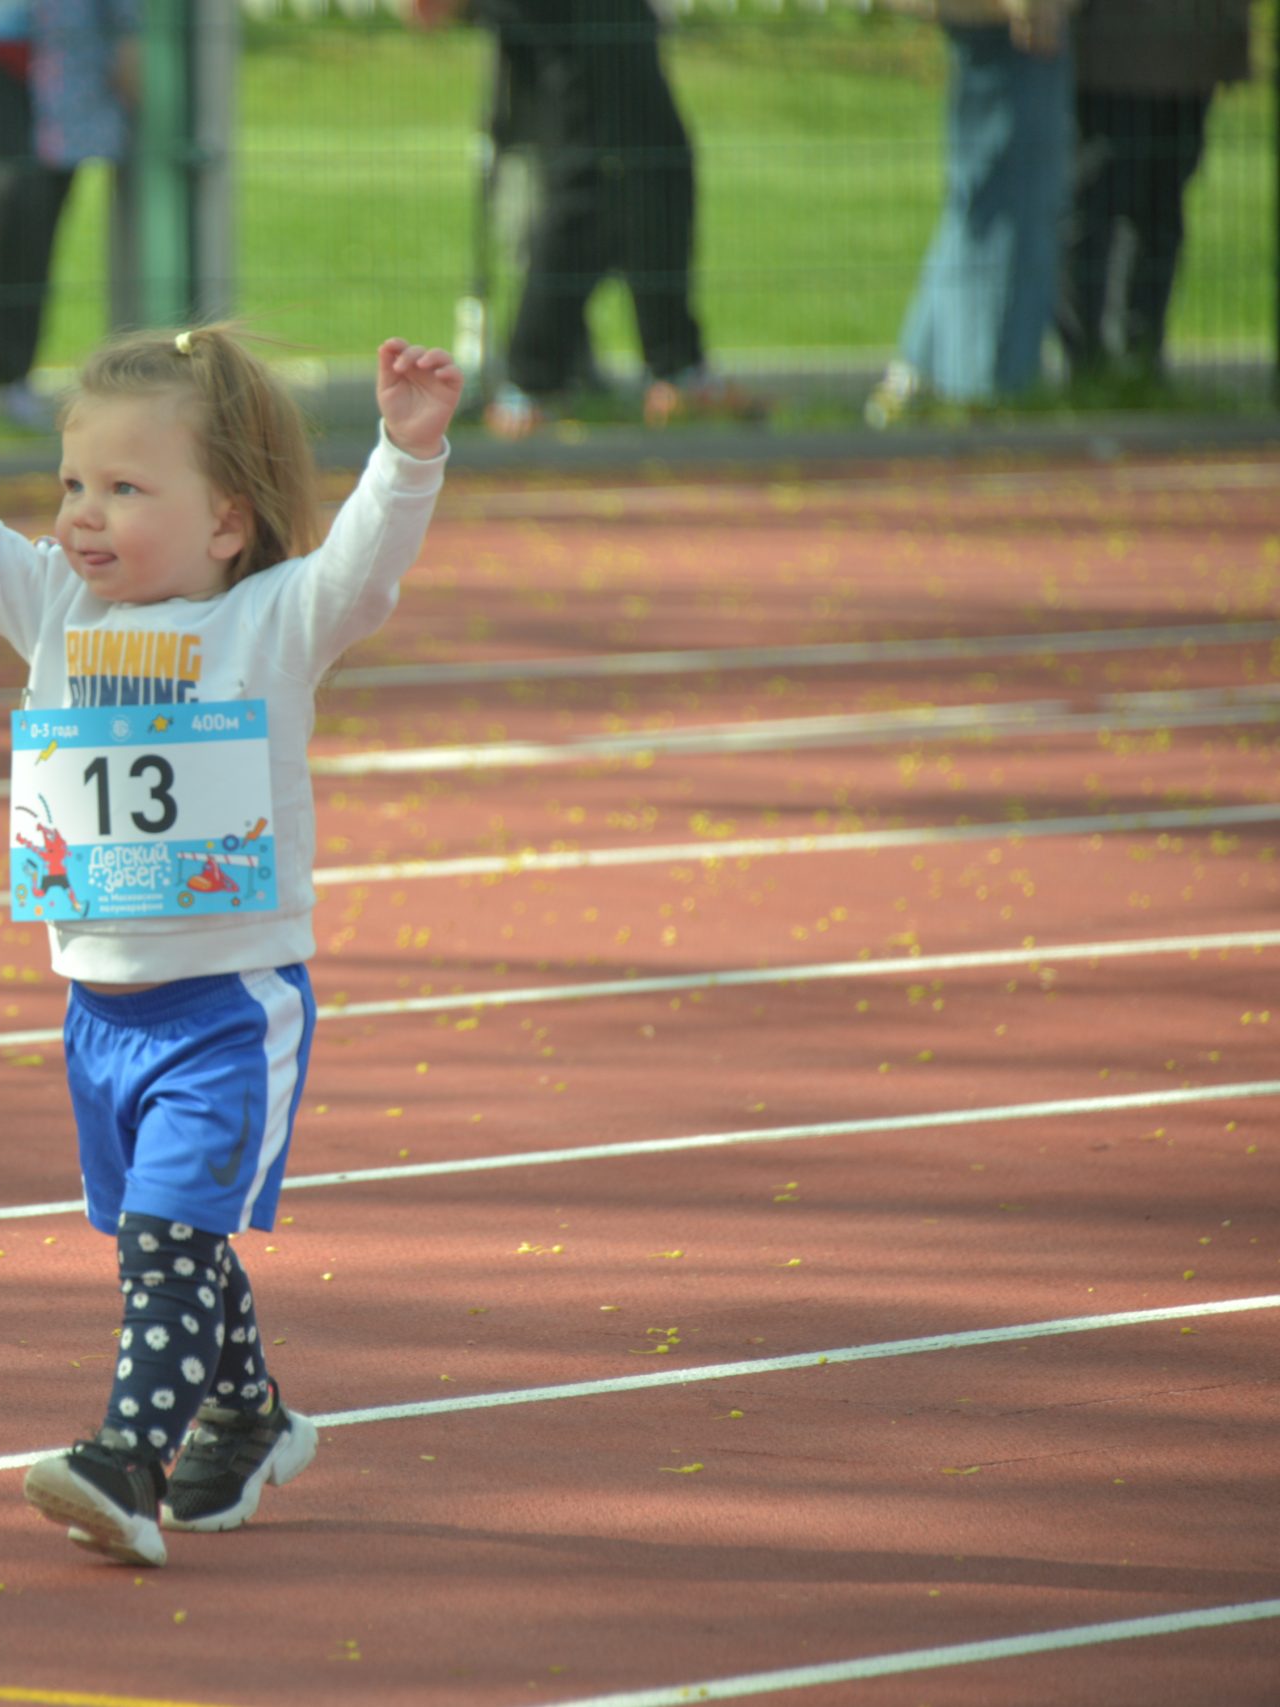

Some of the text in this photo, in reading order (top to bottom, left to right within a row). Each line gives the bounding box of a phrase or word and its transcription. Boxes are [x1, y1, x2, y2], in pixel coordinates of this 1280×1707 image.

[67, 630, 202, 682] RUNNING
[52, 725, 79, 738] года
[83, 754, 178, 837] 13
